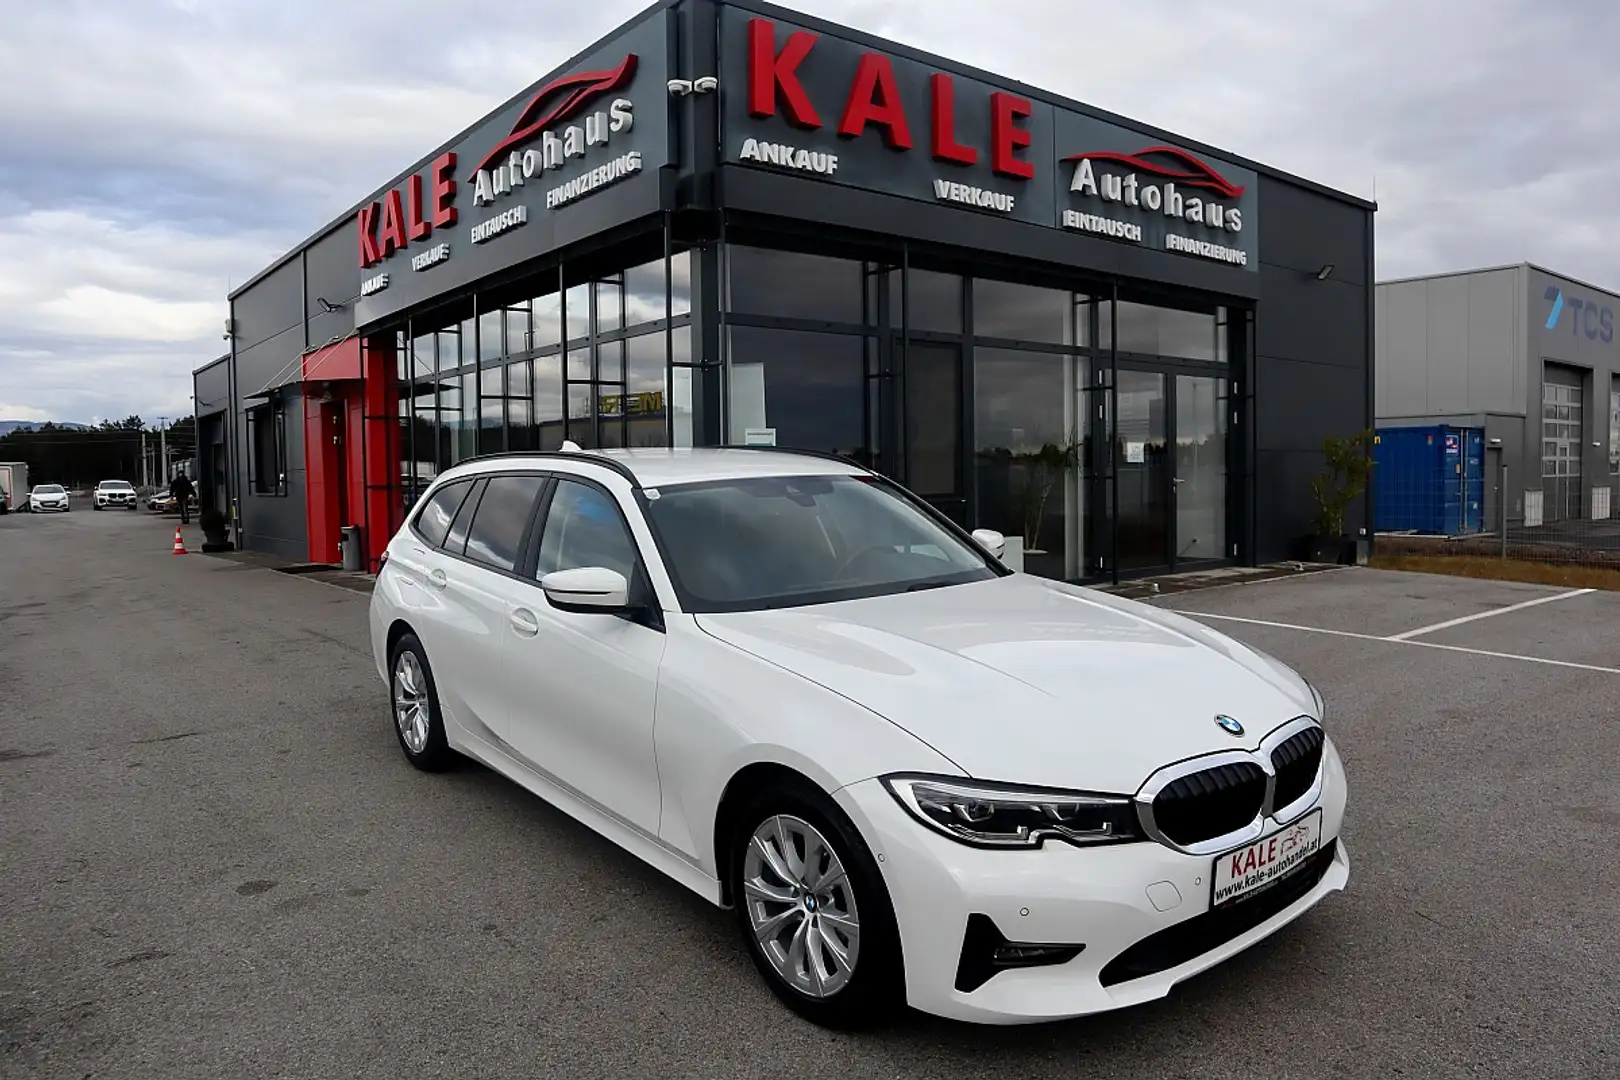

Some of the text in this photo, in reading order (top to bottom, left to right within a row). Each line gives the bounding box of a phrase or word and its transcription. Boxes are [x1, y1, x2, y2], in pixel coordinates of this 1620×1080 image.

[747, 17, 1242, 232] KALE Autohaus
[357, 98, 633, 268] KALE Autohaus
[470, 205, 527, 244] EINTAUSCH
[546, 151, 642, 209] FINANZIERUNG
[740, 138, 1246, 265] ANKAUF VERKAUF EINTAUSCH FINANZIERUNG
[1567, 297, 1613, 343] TCS
[1216, 838, 1318, 901] www.kale-autohandel.at
[1231, 838, 1277, 878] KALE
